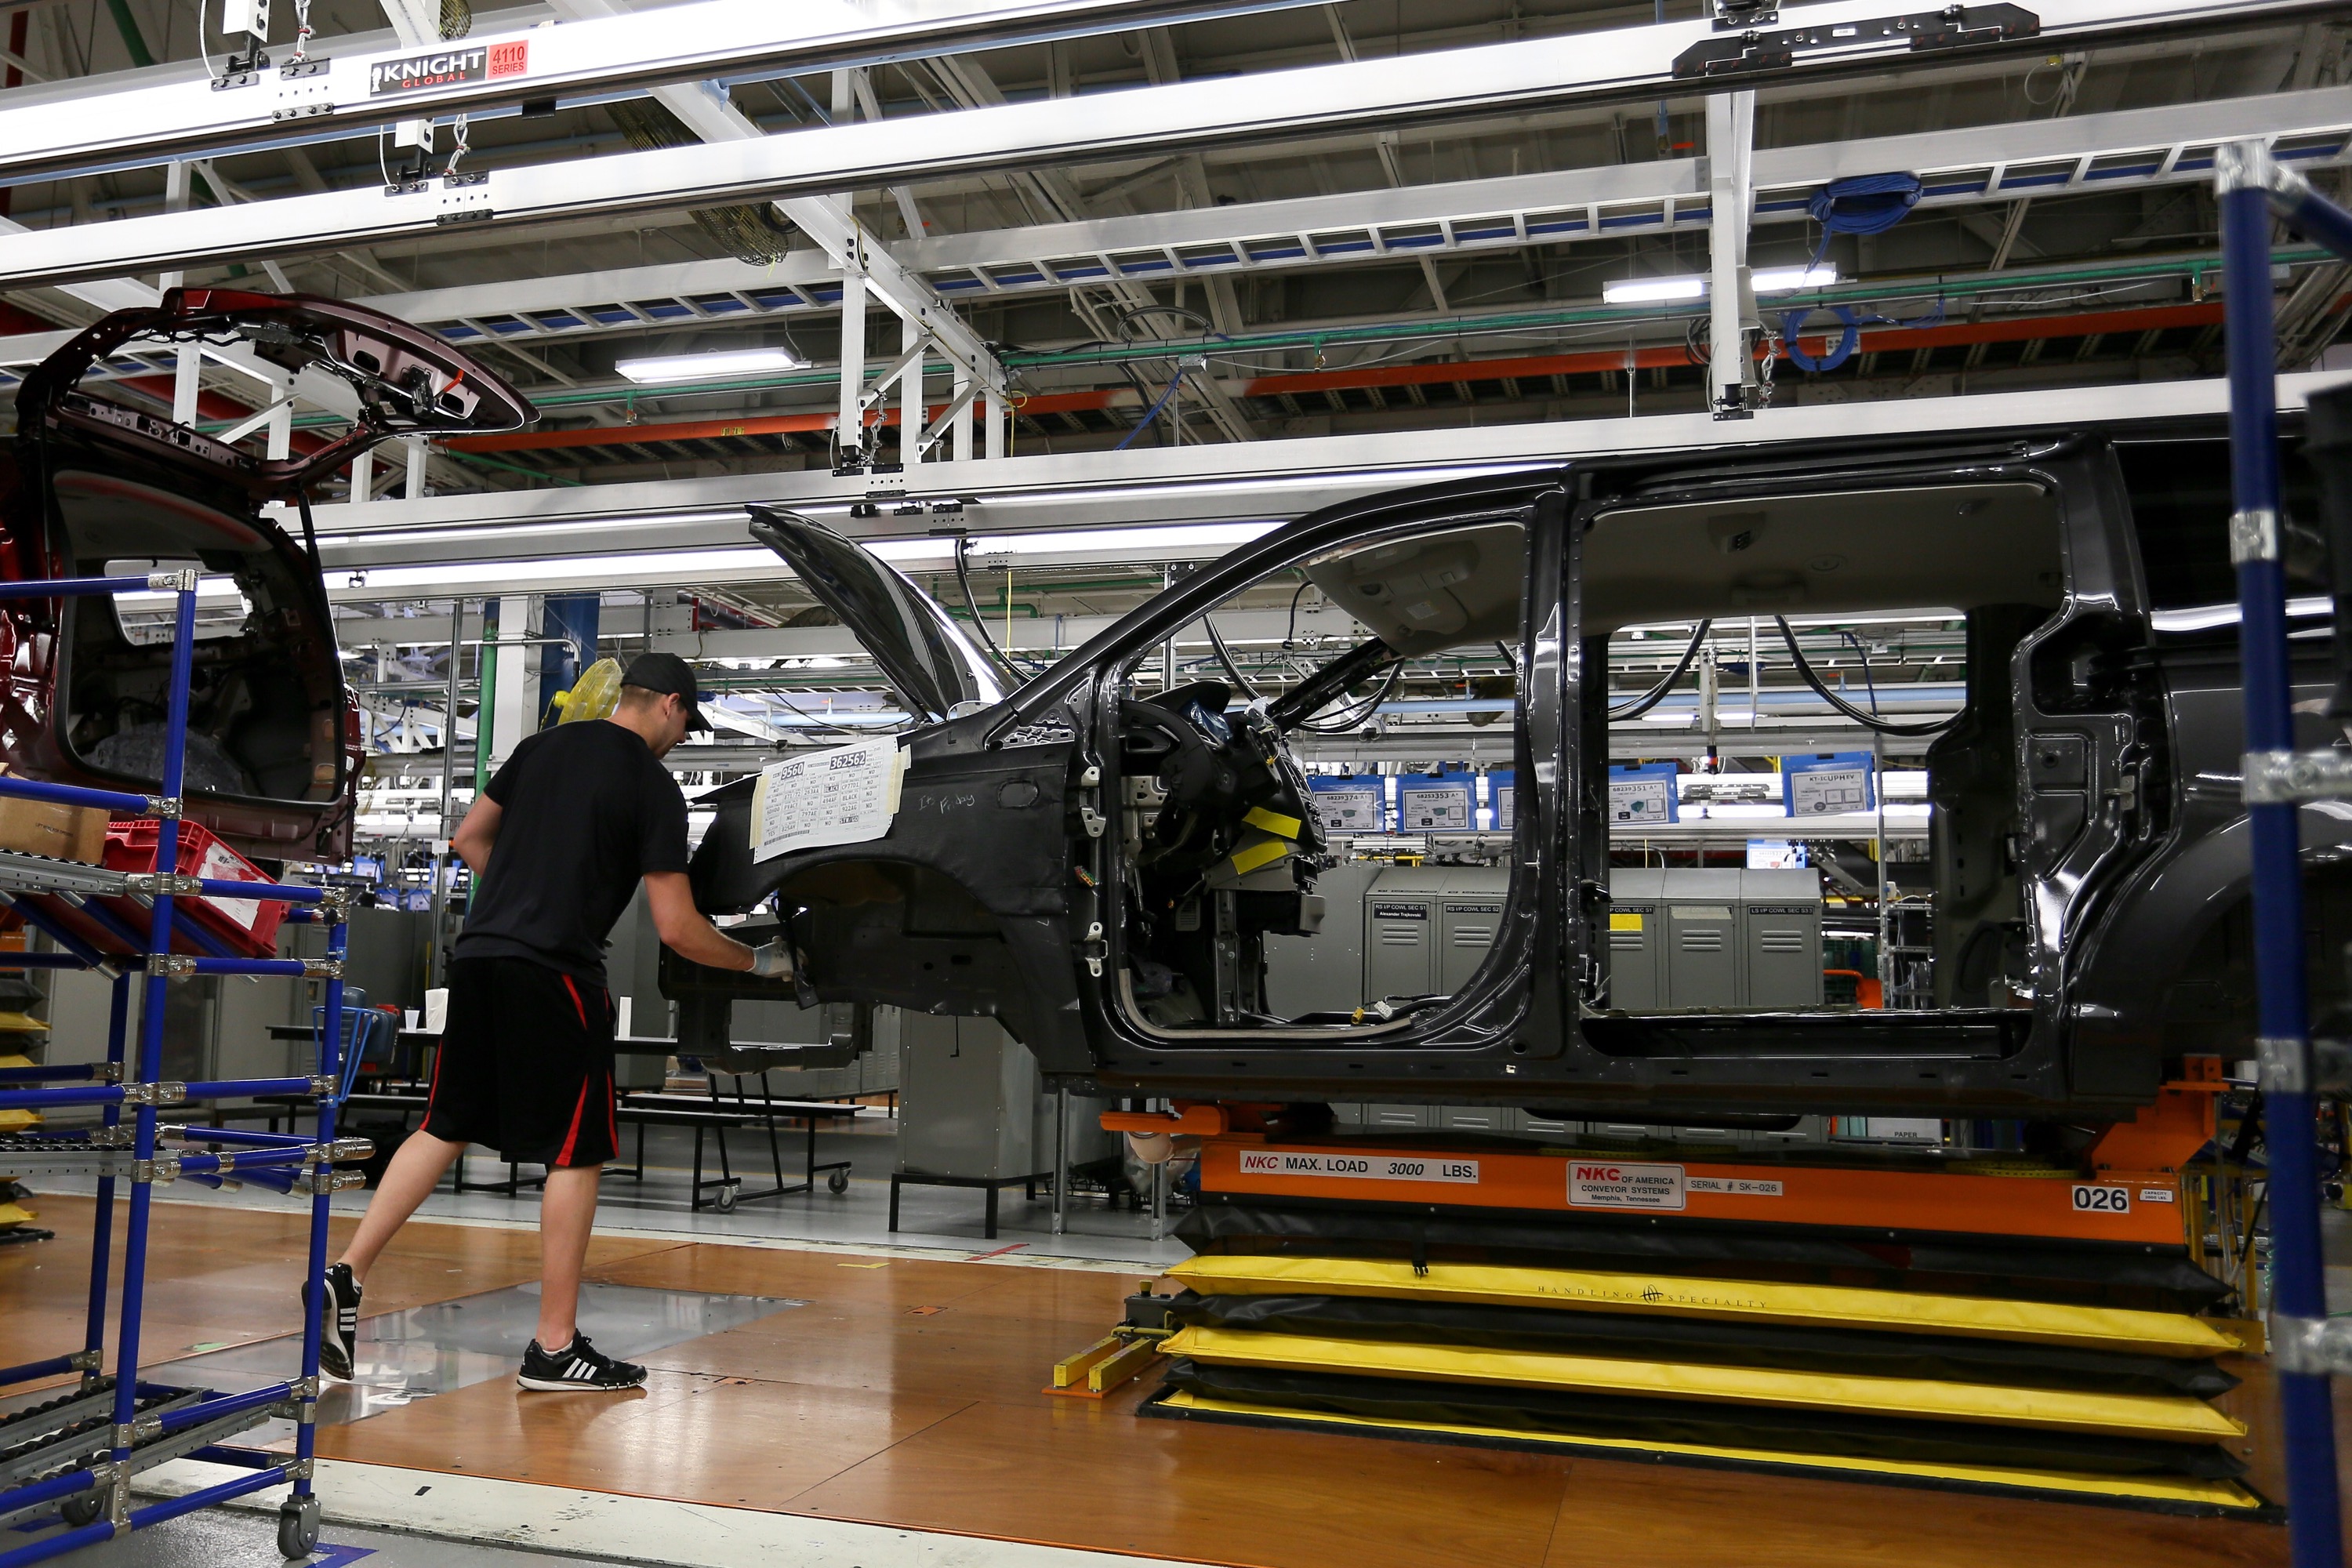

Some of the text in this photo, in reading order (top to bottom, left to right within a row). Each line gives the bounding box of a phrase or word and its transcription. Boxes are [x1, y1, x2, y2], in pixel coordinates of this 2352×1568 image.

[492, 45, 525, 64] 4110
[384, 51, 485, 82] KNIGHT
[492, 61, 524, 75] SERIES
[402, 71, 466, 88] GLOBAL
[782, 763, 804, 779] 9560
[830, 753, 866, 769] 362562
[940, 793, 975, 814] Friday
[1245, 1156, 1477, 1178] NKC MAX. LOAD 3000 LBS.
[1576, 1167, 1621, 1181] NKC
[1635, 1176, 1675, 1185] AMERICA
[1581, 1185, 1670, 1195] CONVEYOR SYSTEMS
[1690, 1180, 1777, 1192] SERIAL # SK-026
[2074, 1187, 2128, 1211] 026
[1537, 1286, 1767, 1308] HANDLING SPECIALTY
